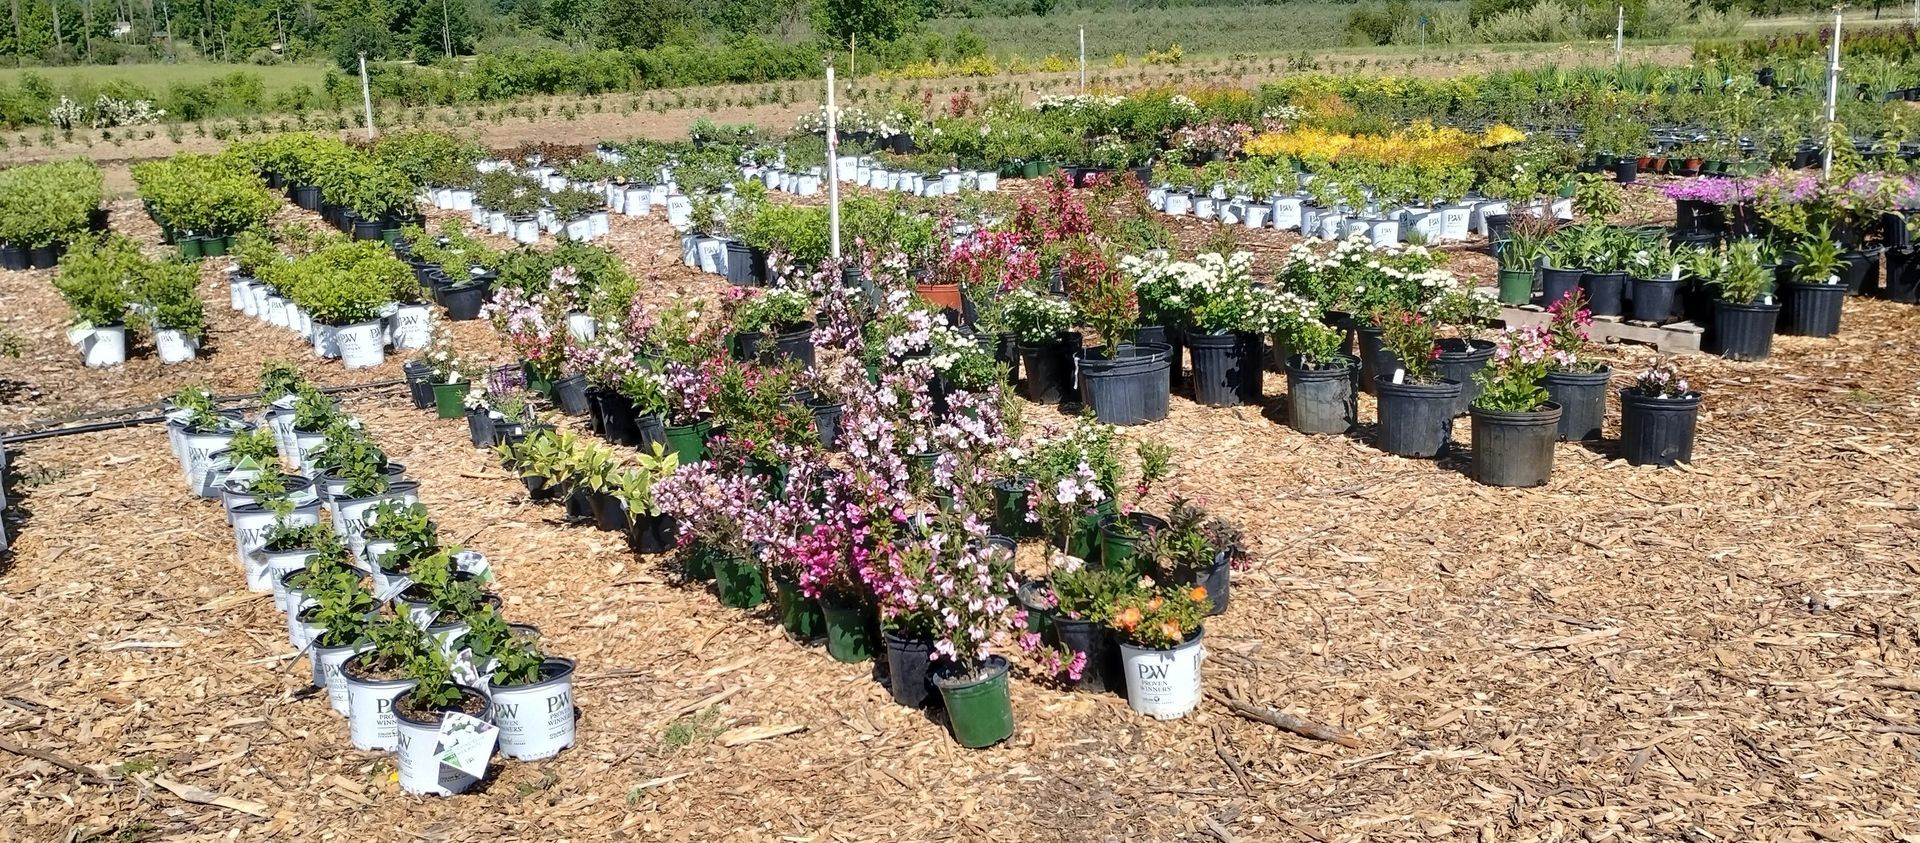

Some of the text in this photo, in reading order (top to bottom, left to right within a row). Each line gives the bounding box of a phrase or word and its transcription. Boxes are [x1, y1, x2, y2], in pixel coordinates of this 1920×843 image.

[1448, 214, 1463, 222] PW
[399, 315, 419, 326] PW
[340, 333, 357, 343] PW
[1138, 663, 1168, 679] PW
[376, 699, 392, 713] P
[546, 691, 569, 713] PW
[493, 703, 519, 719] PW
